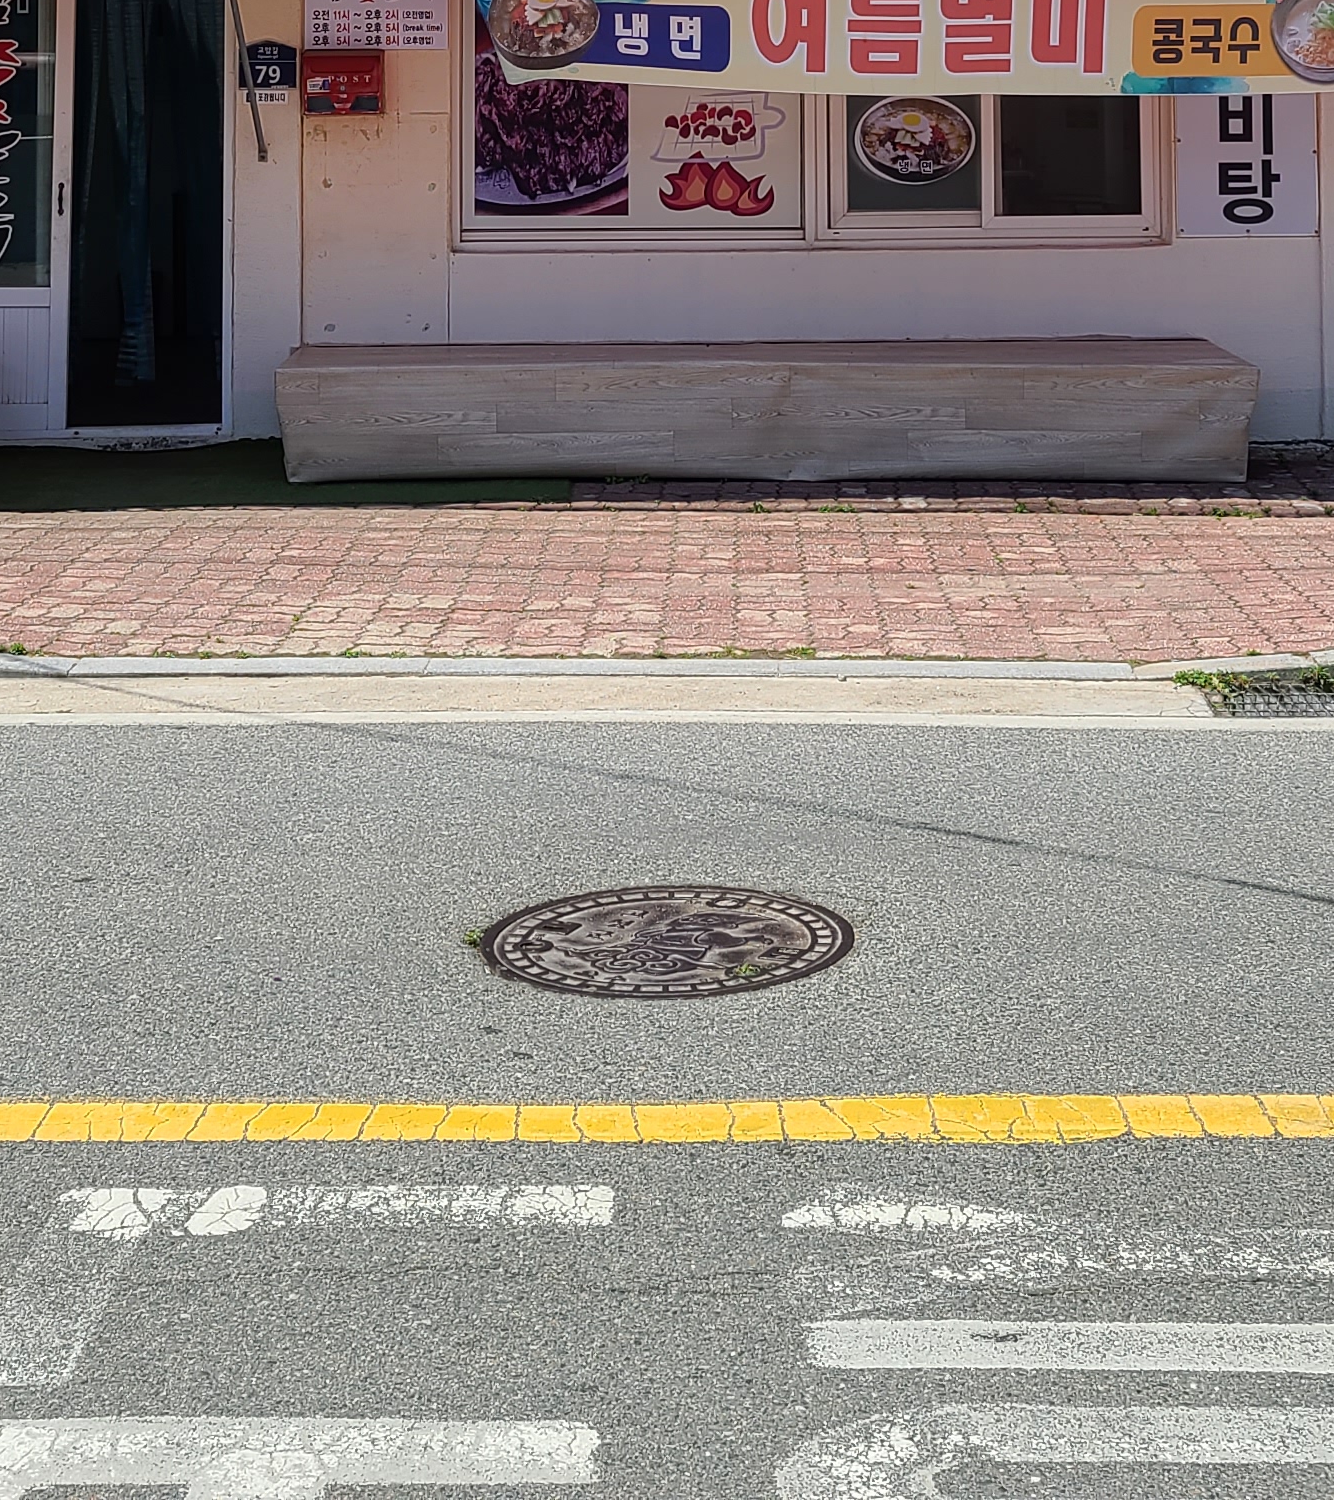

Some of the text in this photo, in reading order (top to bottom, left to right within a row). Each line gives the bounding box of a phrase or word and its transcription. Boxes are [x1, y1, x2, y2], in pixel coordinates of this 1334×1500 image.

[312, 9, 330, 21] 오전
[333, 9, 350, 21] 11시
[364, 9, 383, 21] 오후
[385, 9, 399, 21] 2시
[312, 22, 330, 34] 오후
[336, 22, 350, 34] 2시
[364, 22, 383, 34] 오후
[385, 22, 400, 34] 5시
[312, 35, 330, 47] 오후
[336, 35, 350, 47] 5시
[364, 35, 383, 47] 오후
[385, 35, 400, 47] 8시
[614, 12, 702, 61] 냉면
[1151, 16, 1261, 65] 콩국수
[255, 65, 281, 84] 79
[328, 74, 371, 84] POST
[897, 159, 933, 175] 냉면
